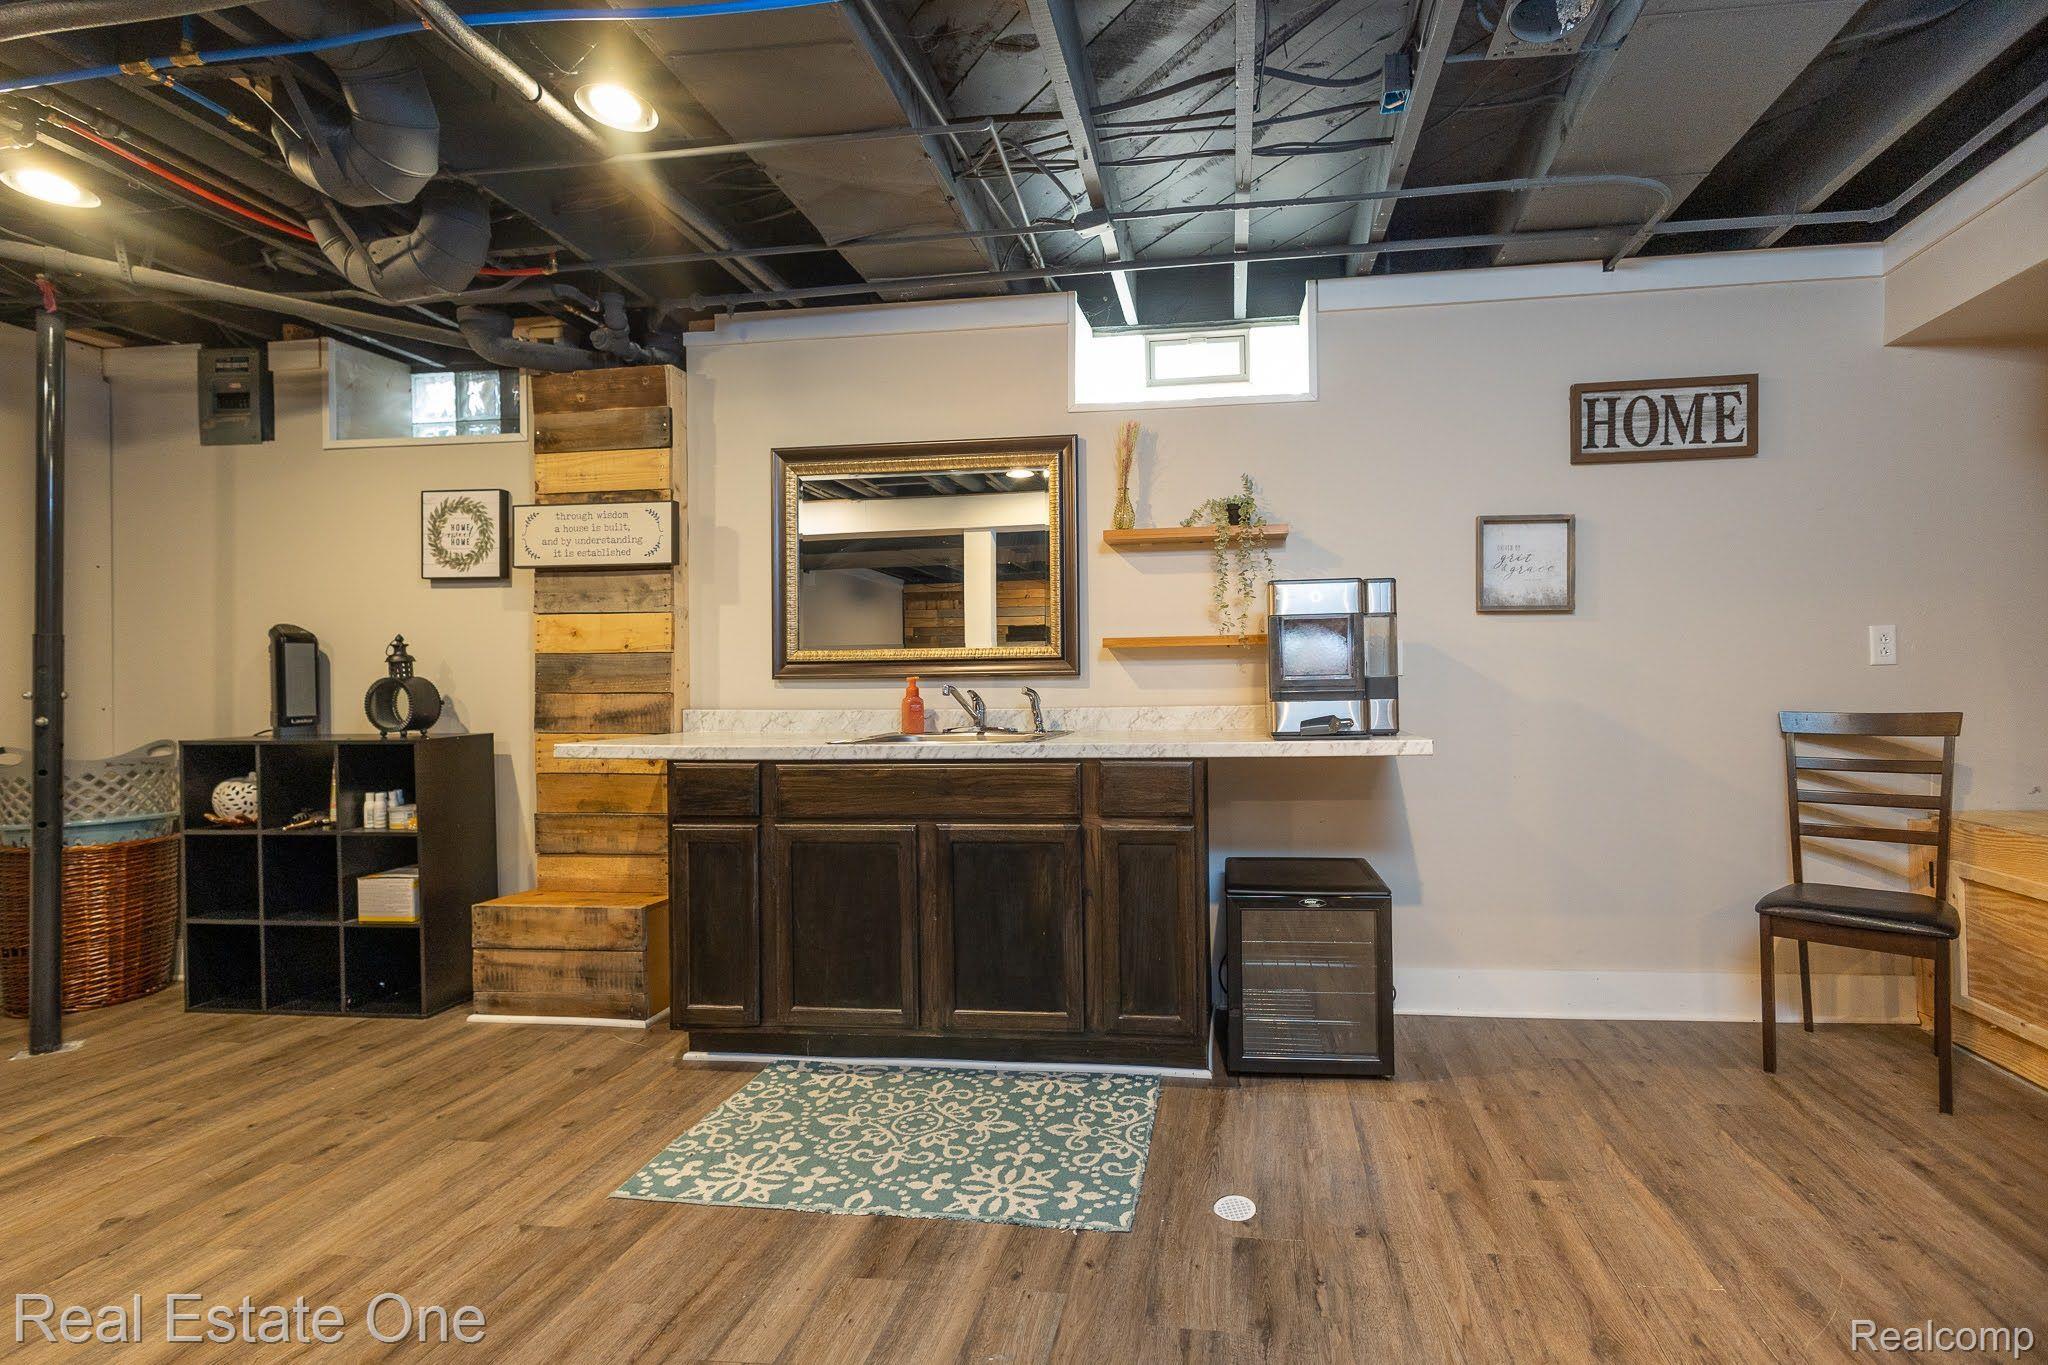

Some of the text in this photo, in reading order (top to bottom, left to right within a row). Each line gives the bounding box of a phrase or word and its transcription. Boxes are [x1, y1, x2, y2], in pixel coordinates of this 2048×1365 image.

[1583, 391, 1745, 450] HOME
[556, 510, 629, 521] through wisdom
[450, 523, 470, 531] HOME
[563, 525, 589, 533] house
[591, 524, 601, 532] is
[604, 523, 631, 532] built,
[450, 538, 470, 546] HOME
[541, 535, 643, 546] and by understanding
[553, 548, 632, 558] it is established
[1494, 553, 1532, 569] grit
[1503, 565, 1553, 580] grace
